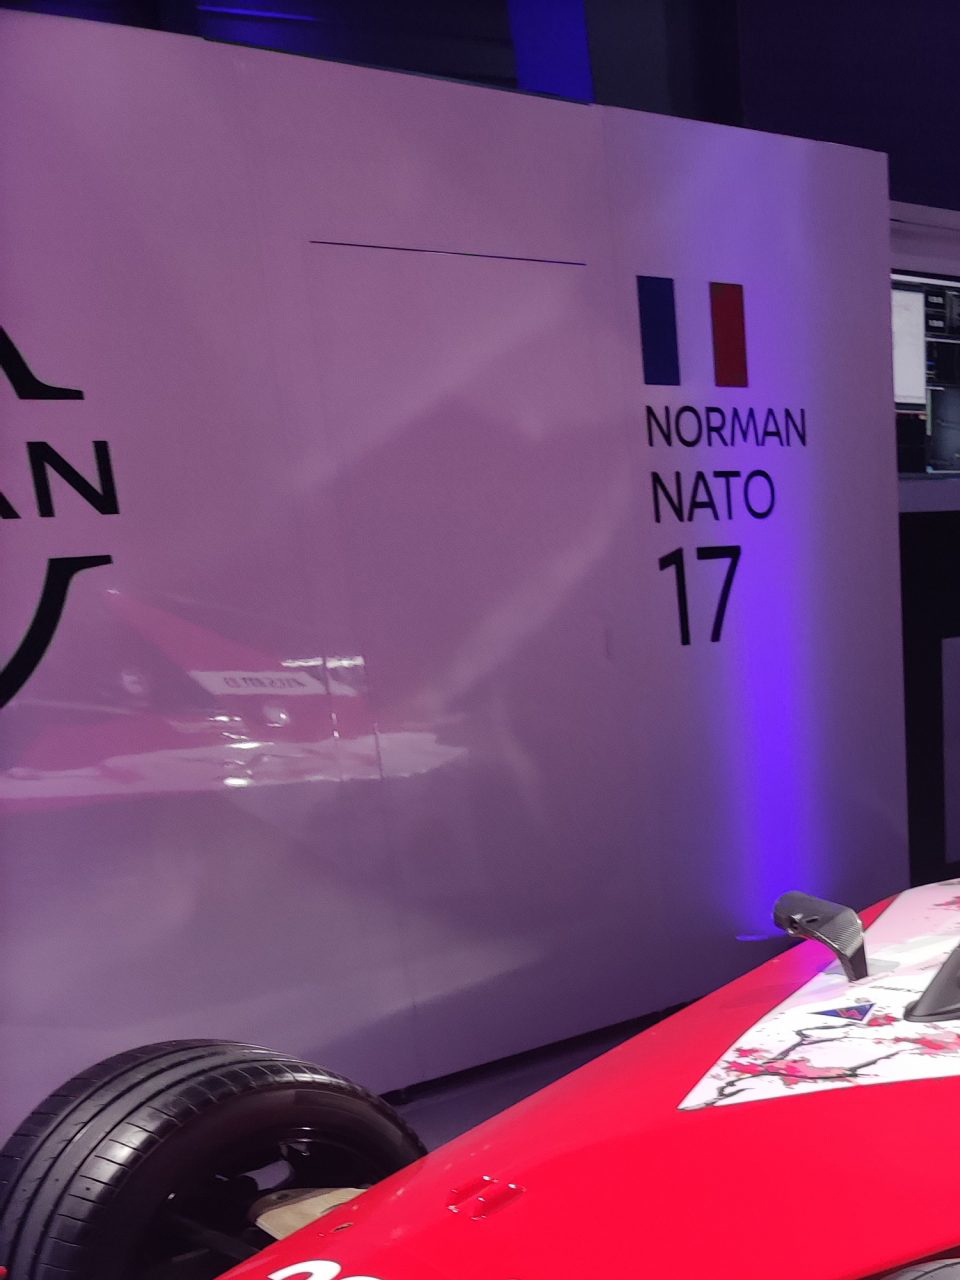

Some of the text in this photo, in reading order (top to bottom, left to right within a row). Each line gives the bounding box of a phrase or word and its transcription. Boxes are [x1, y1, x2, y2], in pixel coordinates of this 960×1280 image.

[646, 404, 807, 447] NORMAN
[651, 469, 776, 523] NATO
[658, 545, 742, 646] 17
